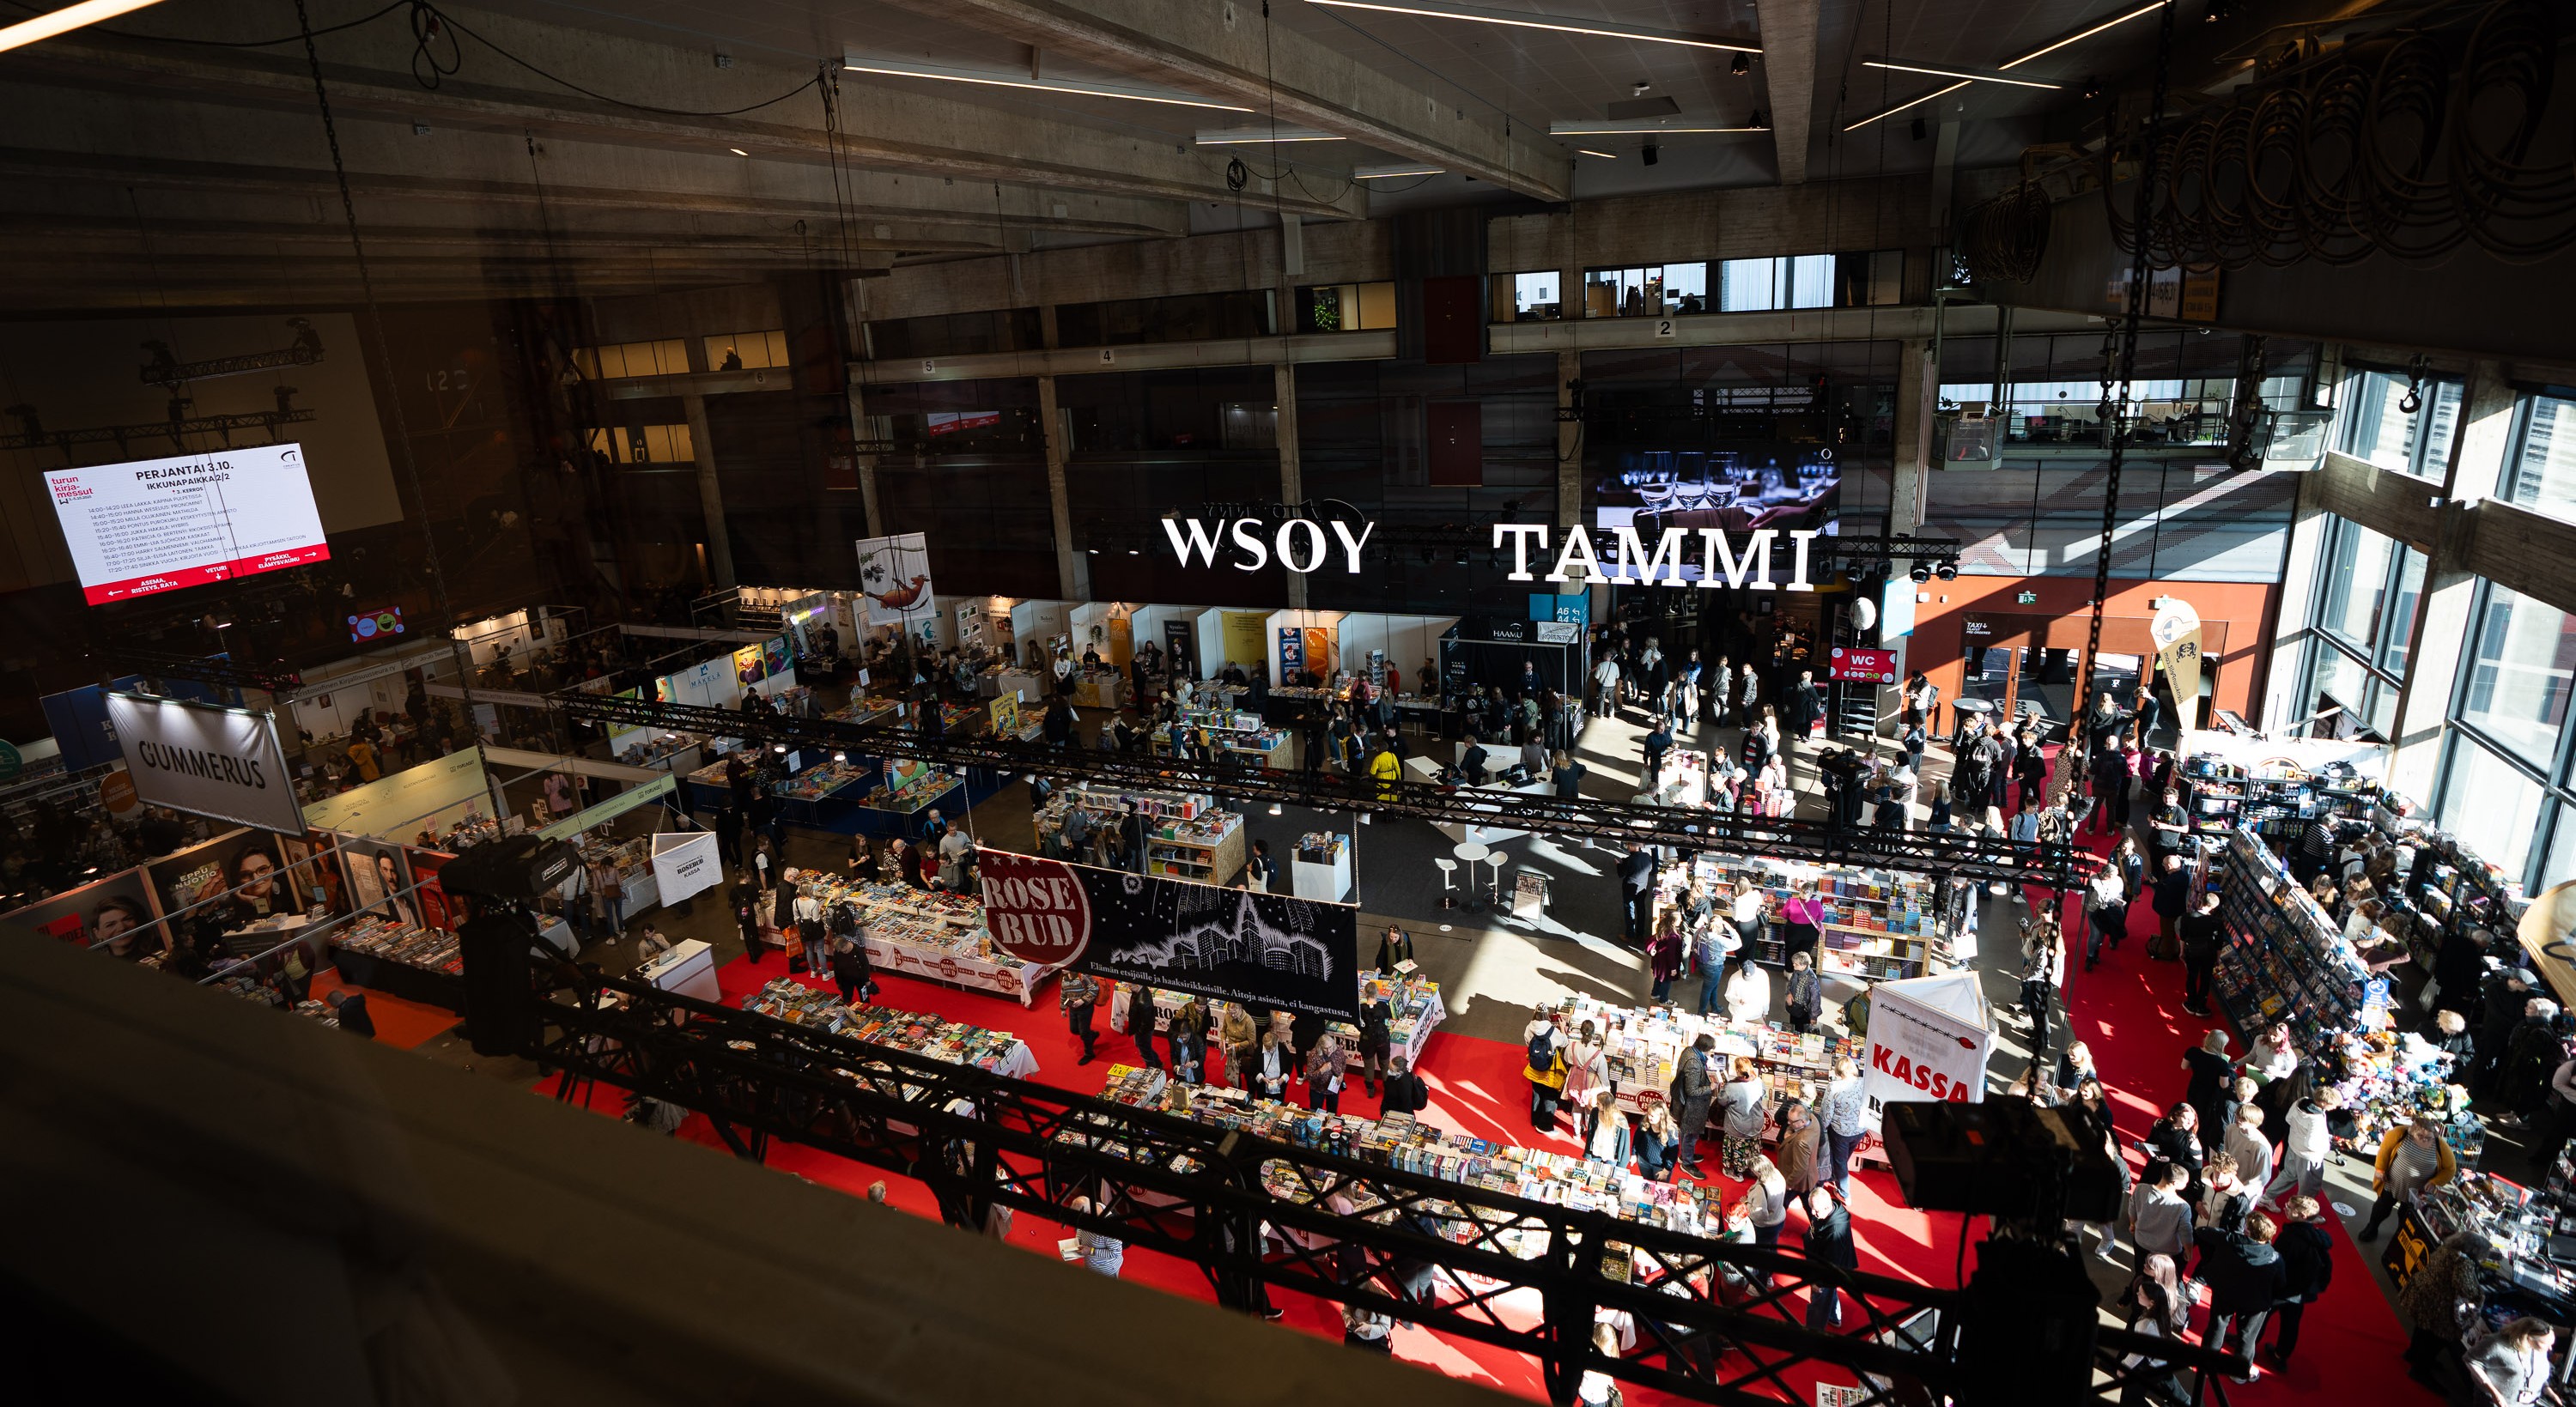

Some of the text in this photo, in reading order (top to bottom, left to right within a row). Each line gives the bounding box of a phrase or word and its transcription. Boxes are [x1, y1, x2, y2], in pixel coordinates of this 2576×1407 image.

[1660, 322, 1670, 334] 2
[1103, 351, 1111, 361] 4
[926, 361, 933, 372] 5
[135, 460, 234, 480] PERJANTAI 3.10.
[146, 472, 230, 490] IKKUNAPAIKKA 2/2
[54, 483, 80, 492] kirja-
[57, 488, 94, 498] messut
[170, 500, 203, 508] PRONOMINIT
[131, 533, 156, 542] PATRICIA
[1162, 518, 1374, 573] WSOY
[179, 552, 203, 561] KIRJOITA
[257, 555, 300, 568] ELÄMYSVAUNU
[264, 552, 290, 562] PYSÄKKI,
[1493, 524, 1817, 591] TAMMI
[204, 565, 227, 573] VETURI
[140, 577, 166, 586] ASEMA,
[131, 584, 160, 594] RISTEYS,
[1493, 630, 1522, 639] HAAMU
[1851, 655, 1875, 665] WC
[339, 669, 389, 685] Kirjallisuusseura
[690, 671, 721, 688] MÄKELÄ
[139, 741, 265, 790] GUMMERUS
[677, 858, 704, 875] ROSEBUD
[179, 867, 208, 882] EPPU
[683, 867, 701, 879] KASSA
[174, 870, 217, 890] NUOTIO
[984, 876, 1077, 910] ROSE
[998, 913, 1074, 947] BUD
[941, 963, 957, 972] ROSE
[1090, 961, 1119, 975] Elämän
[1120, 966, 1152, 984] etsijöille
[1152, 973, 1161, 985] ja
[1162, 974, 1229, 996] haaksirikkoisille.
[1230, 988, 1257, 1003] Aitoja
[1257, 994, 1288, 1008] asioita,
[1297, 998, 1352, 1018] kangastusta.
[1873, 1043, 1968, 1102] KASSA
